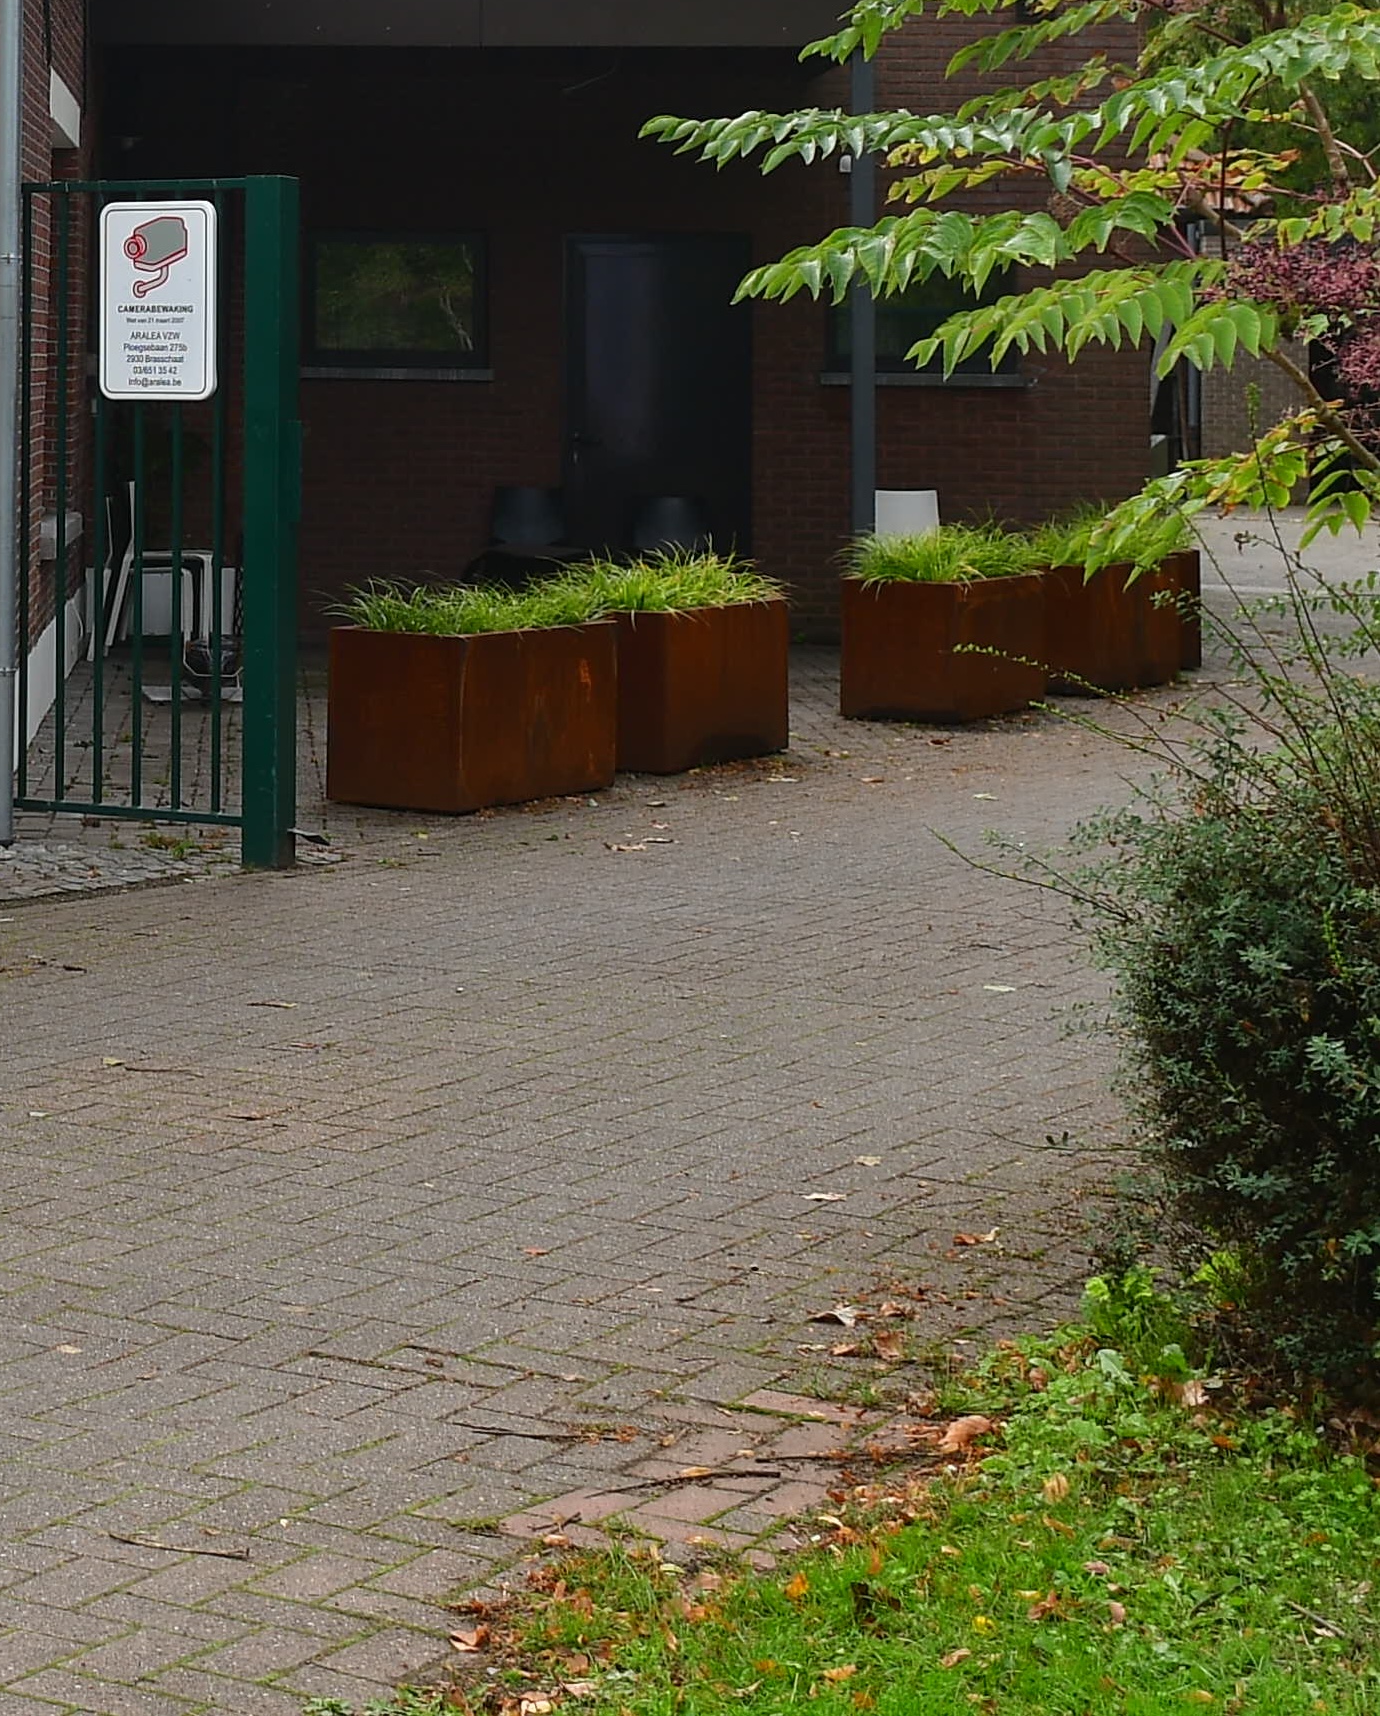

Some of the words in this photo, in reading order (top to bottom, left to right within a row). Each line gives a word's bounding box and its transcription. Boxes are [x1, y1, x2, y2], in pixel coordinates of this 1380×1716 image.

[117, 305, 193, 313] CAMERABEWAKING
[130, 332, 162, 340] ARALEA
[162, 332, 181, 340] VZW
[126, 354, 144, 363] 2930
[169, 366, 177, 375] 42
